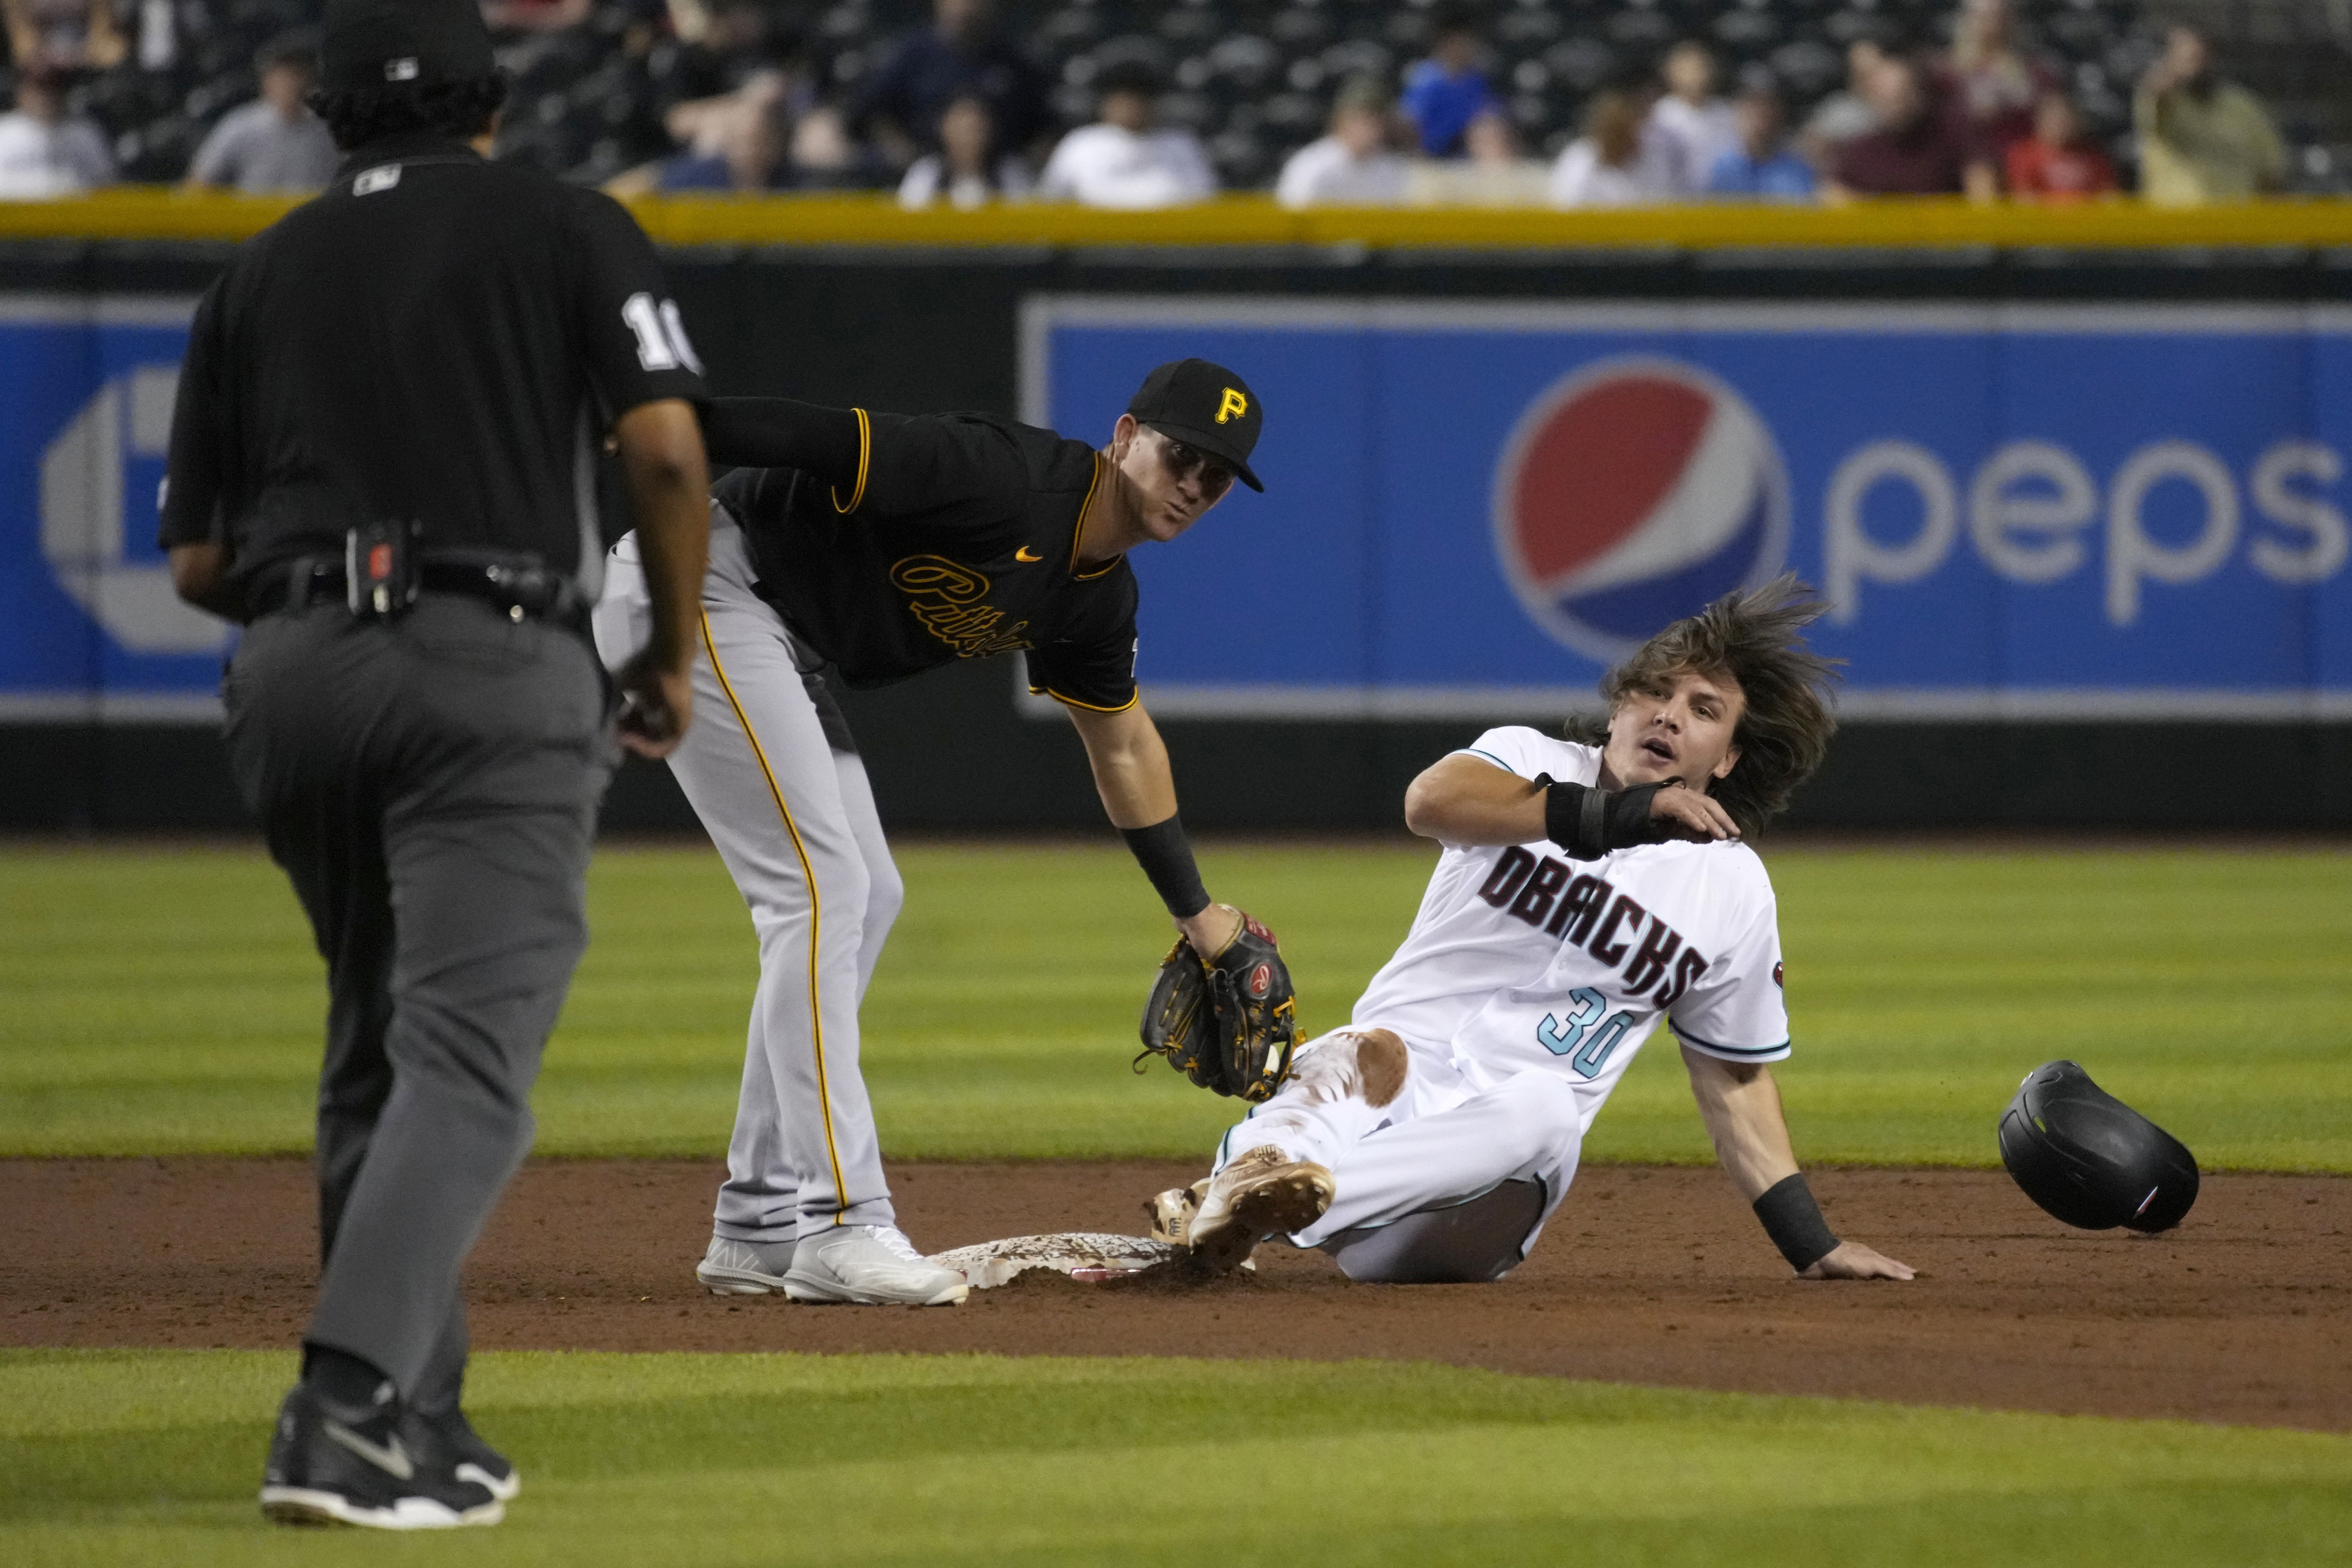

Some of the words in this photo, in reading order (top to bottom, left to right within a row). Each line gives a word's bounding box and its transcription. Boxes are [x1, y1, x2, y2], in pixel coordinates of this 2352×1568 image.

[1215, 387, 1248, 424] P
[1477, 845, 1710, 1009] DBACKS
[1537, 987, 1635, 1079] 30
